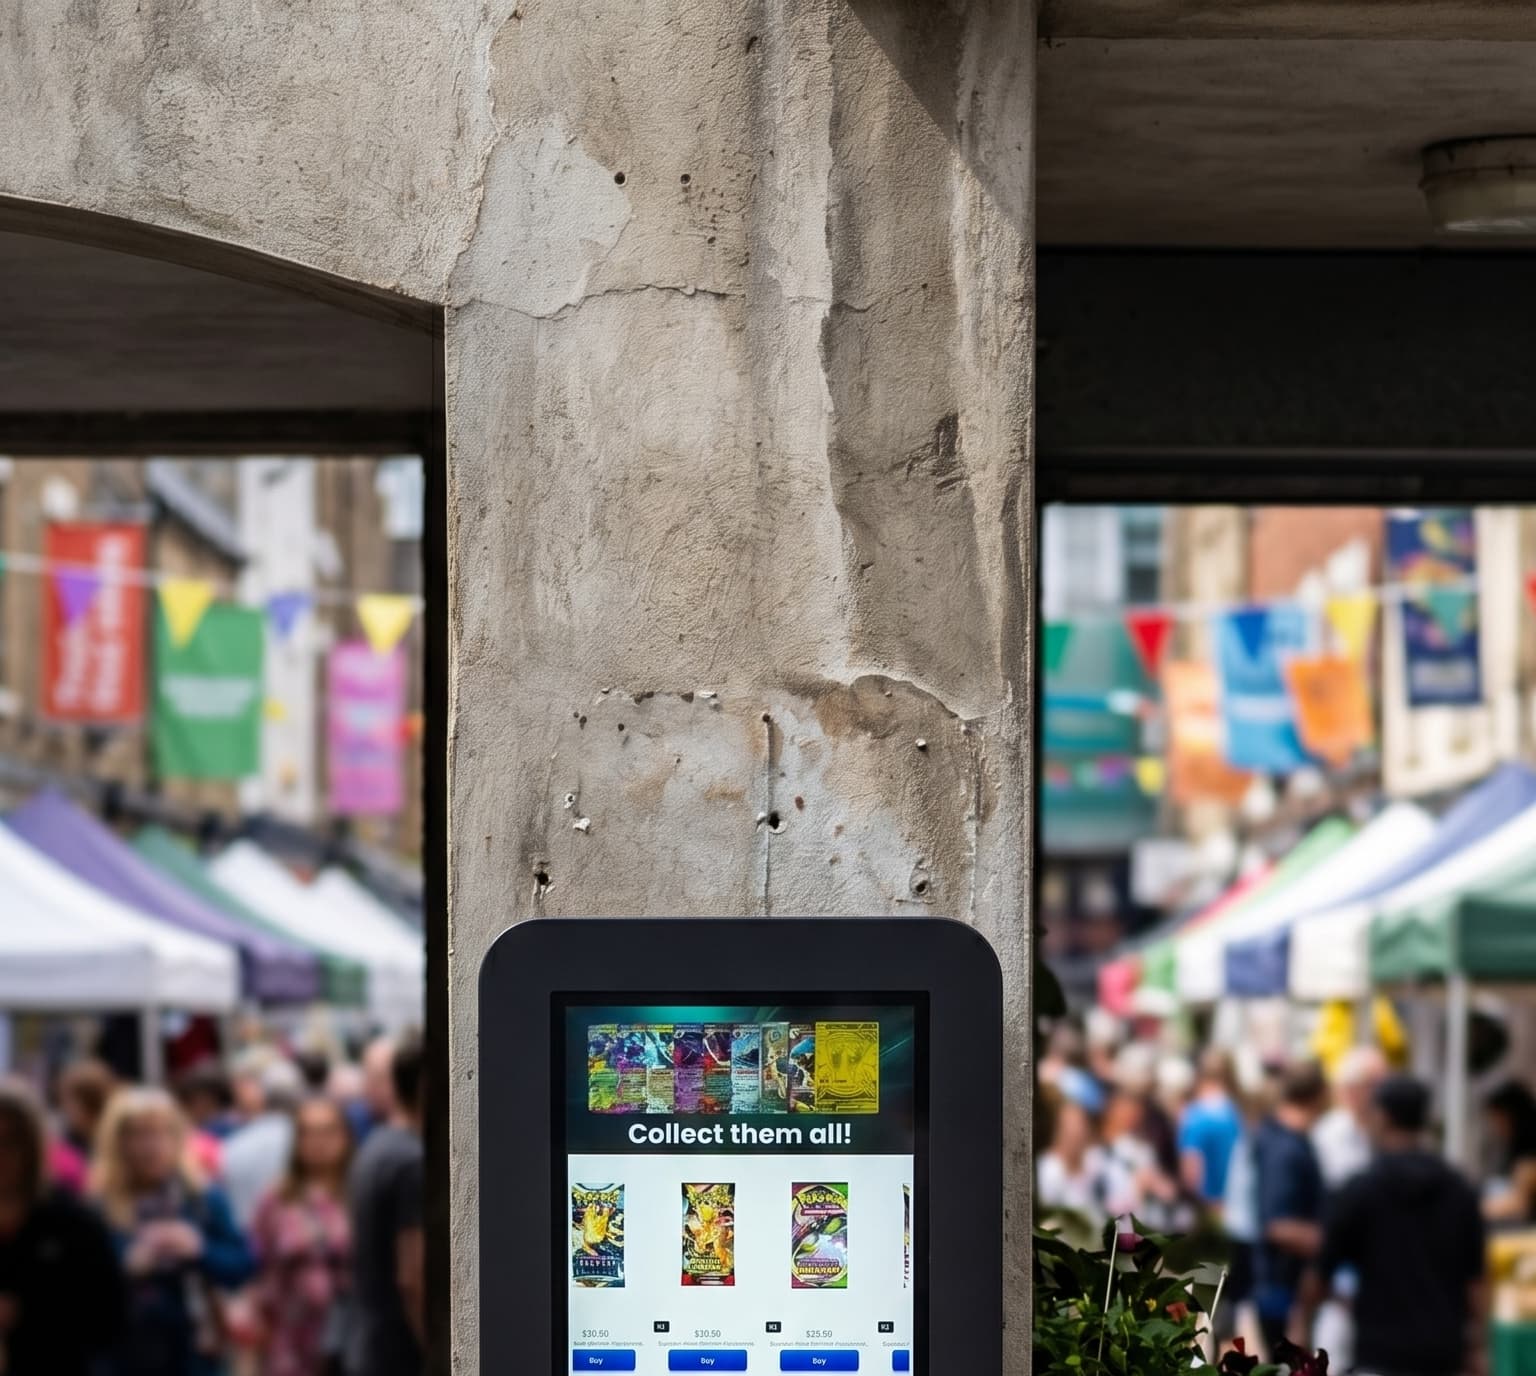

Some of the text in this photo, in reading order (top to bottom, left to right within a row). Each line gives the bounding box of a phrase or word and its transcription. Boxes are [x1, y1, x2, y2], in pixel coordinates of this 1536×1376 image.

[628, 1122, 852, 1145] Collect them all!
[582, 1329, 609, 1338] $30.50
[806, 1329, 833, 1338] $25.50
